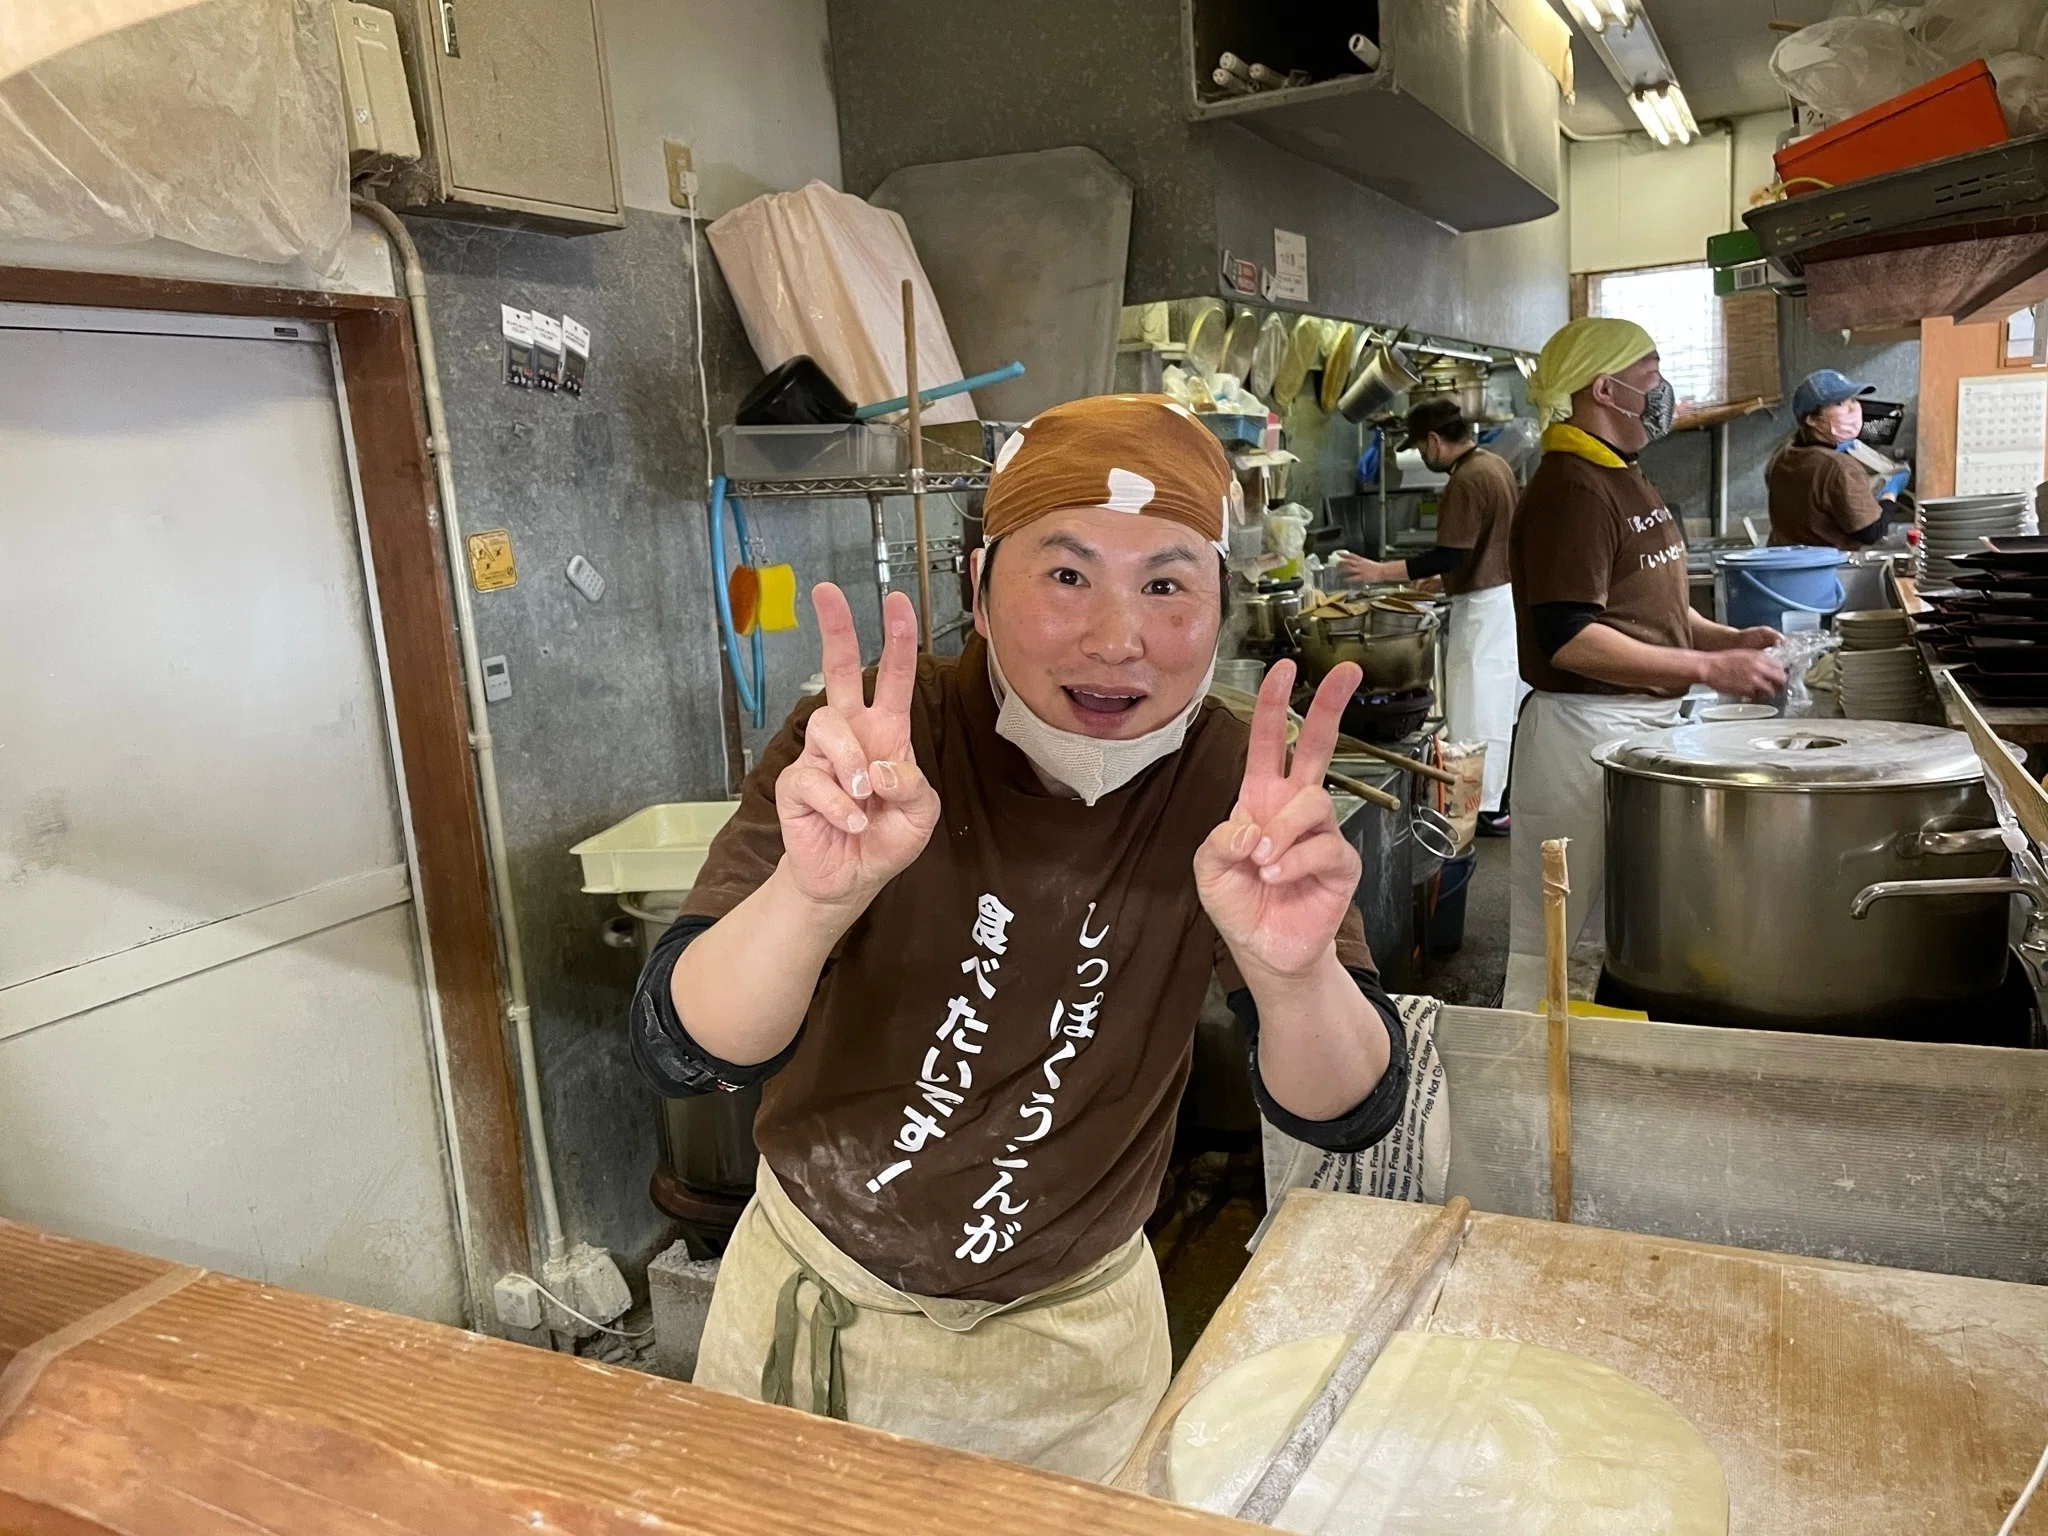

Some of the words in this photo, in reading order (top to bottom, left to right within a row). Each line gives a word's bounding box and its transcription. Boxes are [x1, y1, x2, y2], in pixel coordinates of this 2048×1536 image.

[866, 892, 1015, 1194] 食べたいです！
[1427, 1079, 1441, 1098] Not
[1421, 1098, 1436, 1120] Free
[1367, 1170, 1378, 1197] luten
